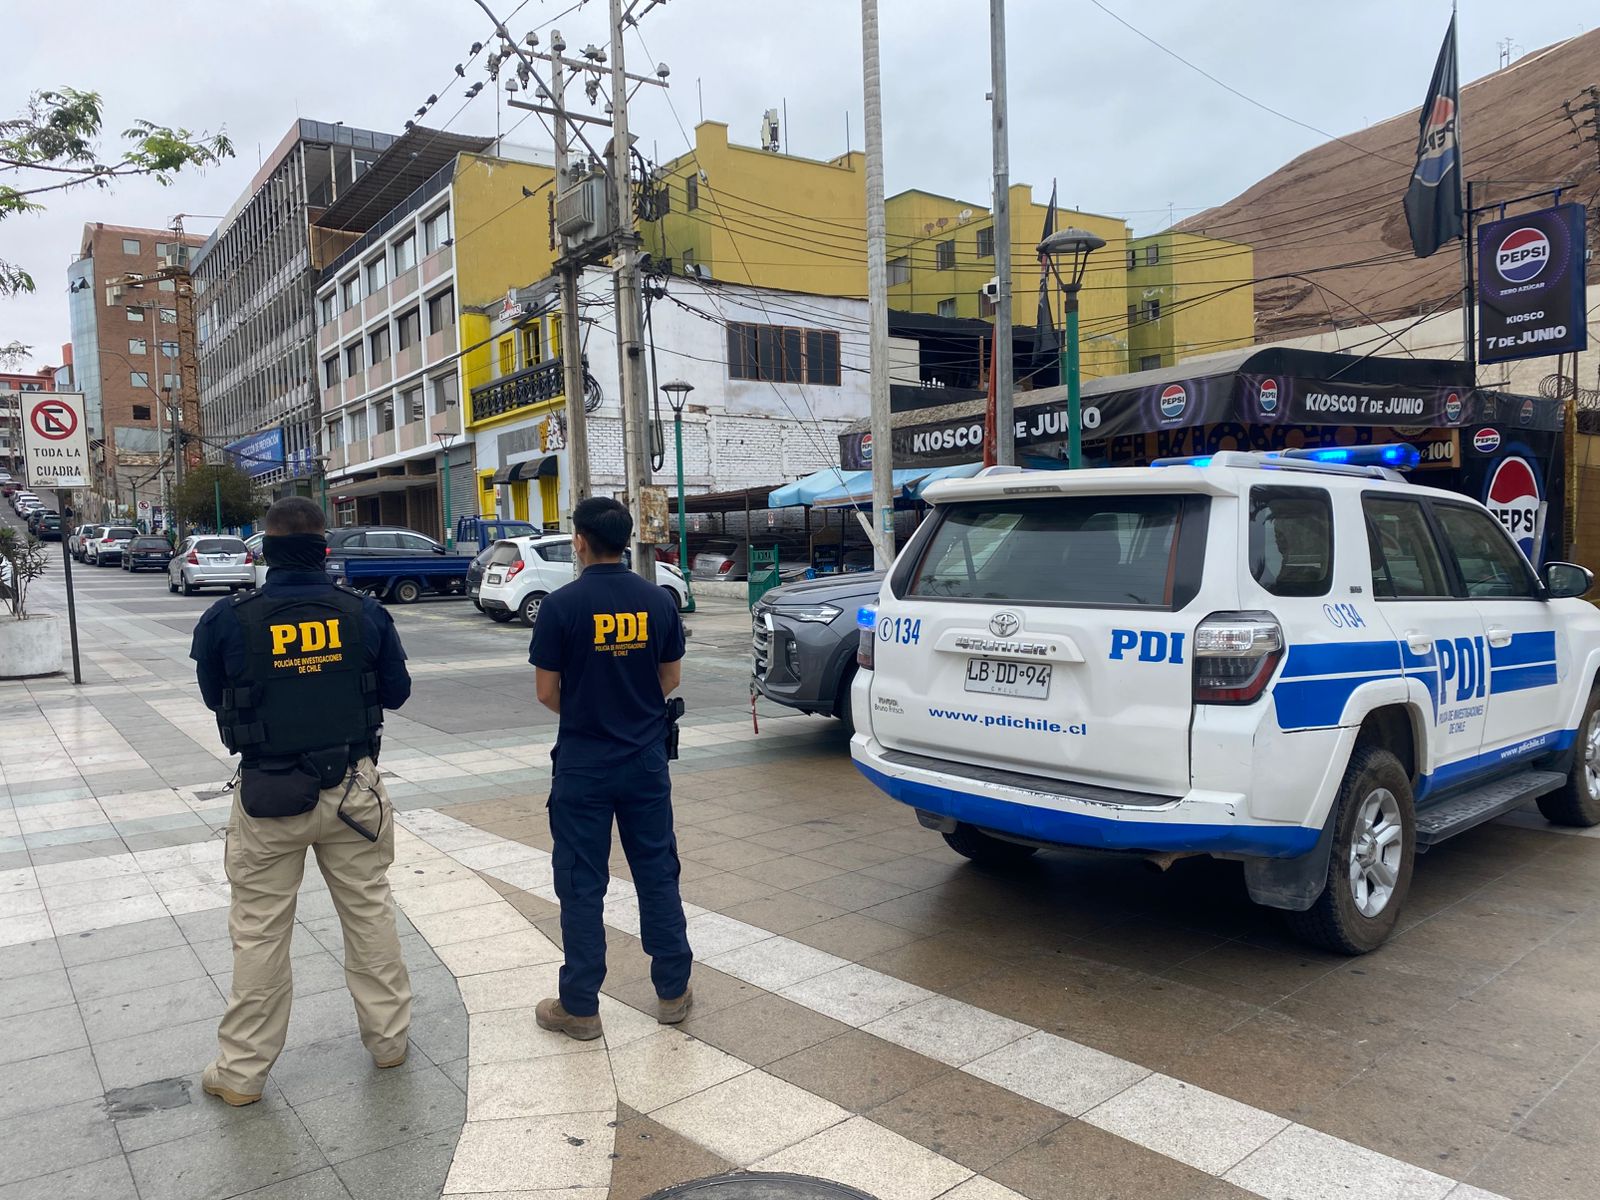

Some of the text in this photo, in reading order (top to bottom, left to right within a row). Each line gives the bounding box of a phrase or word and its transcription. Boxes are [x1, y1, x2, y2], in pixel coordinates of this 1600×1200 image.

[1500, 245, 1546, 265] PEPSI
[1500, 287, 1517, 296] ZERO
[1506, 310, 1545, 325] KIOSCO
[1486, 325, 1567, 349] 7 DE JUNIO
[1162, 397, 1185, 406] PEPSI
[1306, 393, 1423, 414] KIOSCO 7 DE JUNIO
[914, 424, 982, 453] KIOSCO
[1475, 436, 1499, 444] PEPSI
[33, 448, 81, 457] TODA LA
[1427, 441, 1455, 460] 100
[36, 465, 81, 476] CUADRA
[1335, 603, 1366, 628] 134
[270, 619, 342, 655] PDI
[593, 611, 648, 644] PDI
[895, 617, 921, 645] 134
[1109, 629, 1185, 664] PDI
[294, 658, 302, 667] DE
[301, 653, 343, 665] INVESTIGACIONES
[298, 664, 322, 674] DE CHILE
[1434, 635, 1486, 706] PDI
[928, 706, 1087, 736] www.pdichile.cl
[1500, 735, 1546, 759] www.pdichile.cl
